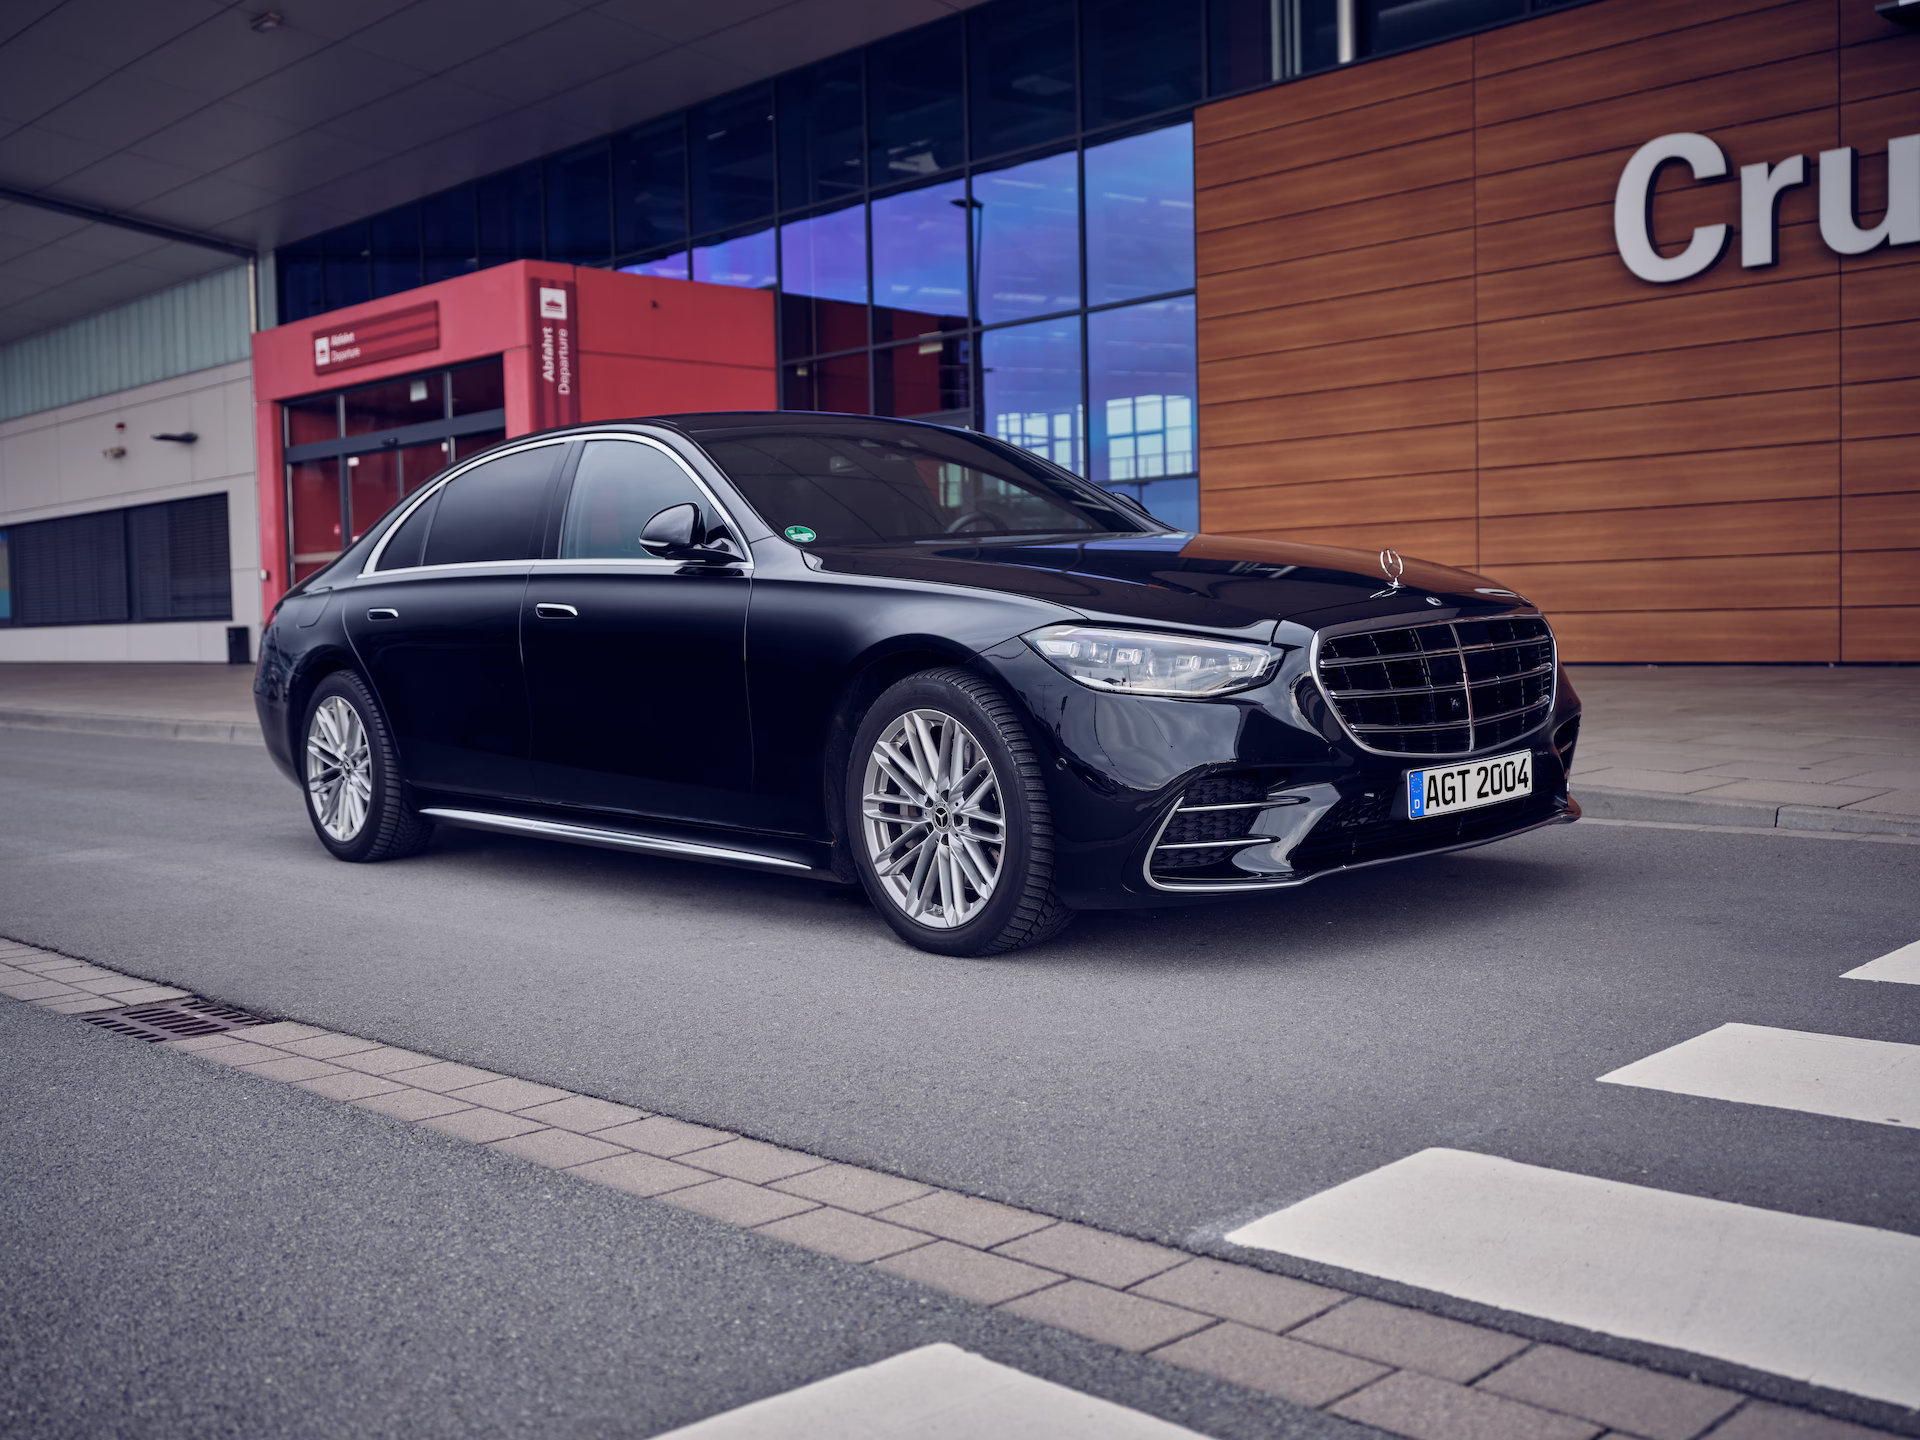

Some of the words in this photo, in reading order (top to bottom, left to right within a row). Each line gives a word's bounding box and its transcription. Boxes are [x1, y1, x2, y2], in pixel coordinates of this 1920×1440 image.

[1614, 132, 1920, 283] Cru
[542, 326, 555, 383] Abfahrt
[558, 328, 571, 395] Departure
[1414, 799, 1420, 809] D
[1425, 769, 1471, 809] AGT
[1476, 758, 1529, 799] 2004
